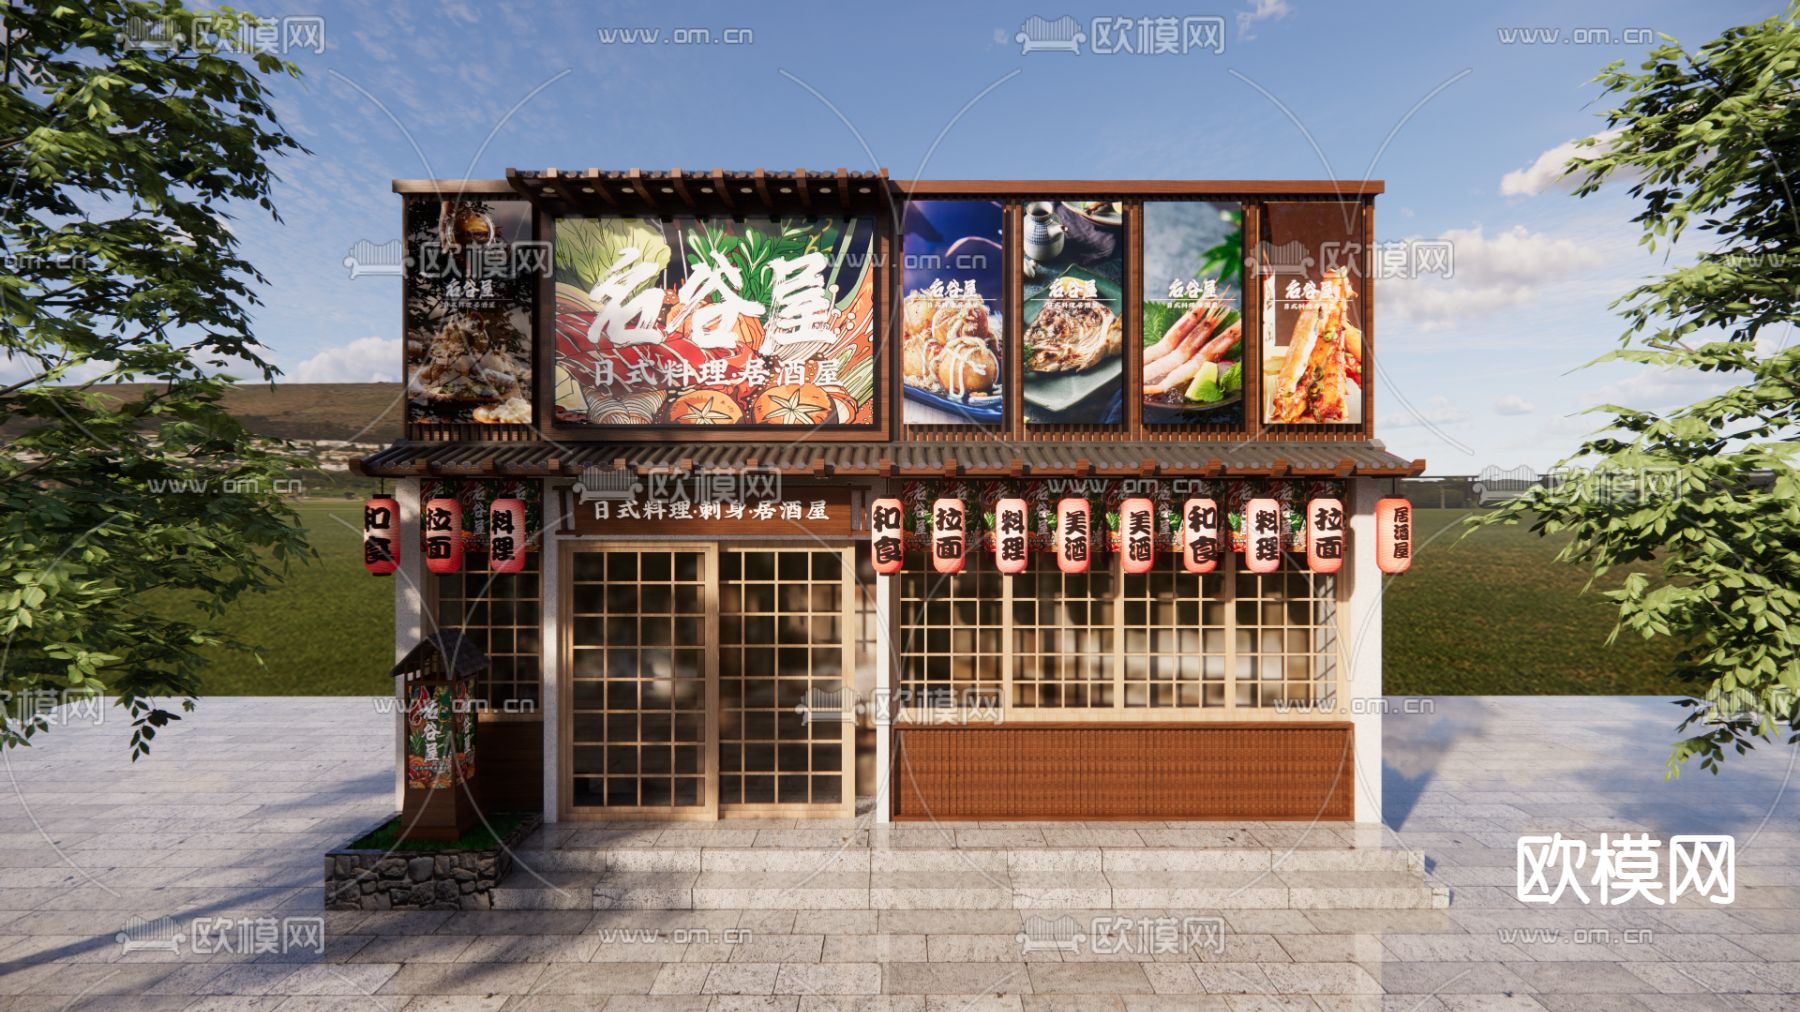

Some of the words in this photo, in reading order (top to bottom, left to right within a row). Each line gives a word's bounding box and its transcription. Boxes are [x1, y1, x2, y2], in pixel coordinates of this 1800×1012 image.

[427, 507, 452, 559] 拉面
[492, 510, 515, 561] 料理
[873, 505, 903, 564] 和食
[935, 507, 963, 560] 拉面
[1001, 509, 1025, 561] 料理
[1065, 510, 1087, 562] 美酒
[1128, 510, 1152, 562] 美酒
[1188, 505, 1218, 564] 和食
[1255, 509, 1279, 561] 料理
[1315, 507, 1344, 560] 拉面
[1393, 506, 1409, 559] 居酒屋
